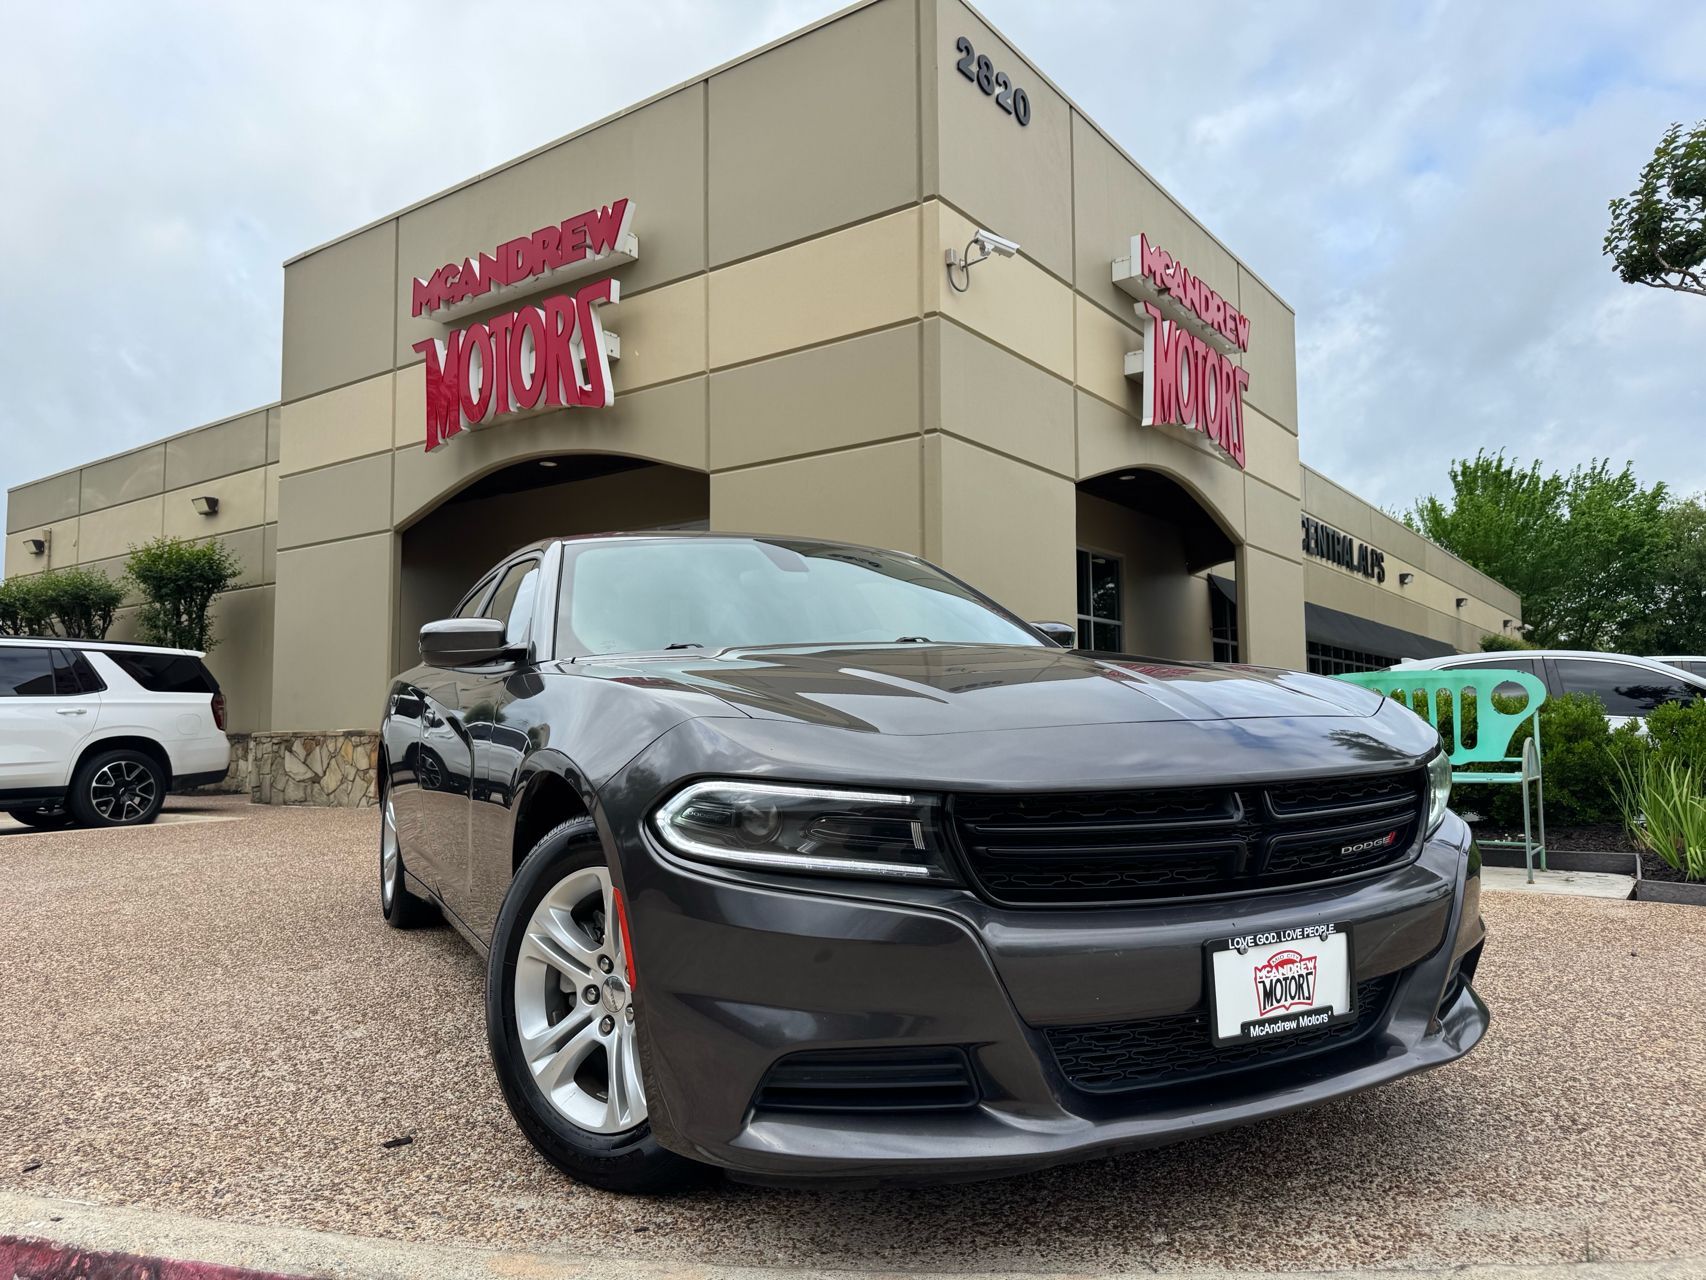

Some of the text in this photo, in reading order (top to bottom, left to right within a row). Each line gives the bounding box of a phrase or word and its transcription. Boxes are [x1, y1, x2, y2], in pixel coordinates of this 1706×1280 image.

[956, 36, 1031, 127] 2820
[411, 276, 613, 453] MOTORS
[1143, 301, 1250, 470] MOTORS
[1358, 543, 1385, 584] ALPS
[1341, 835, 1391, 855] DODGE
[1228, 923, 1337, 950] LOVE GOD. LOVE PEOPLE.
[1257, 971, 1314, 1011] MOTORS
[1249, 1013, 1329, 1038] McAndrew Motors
